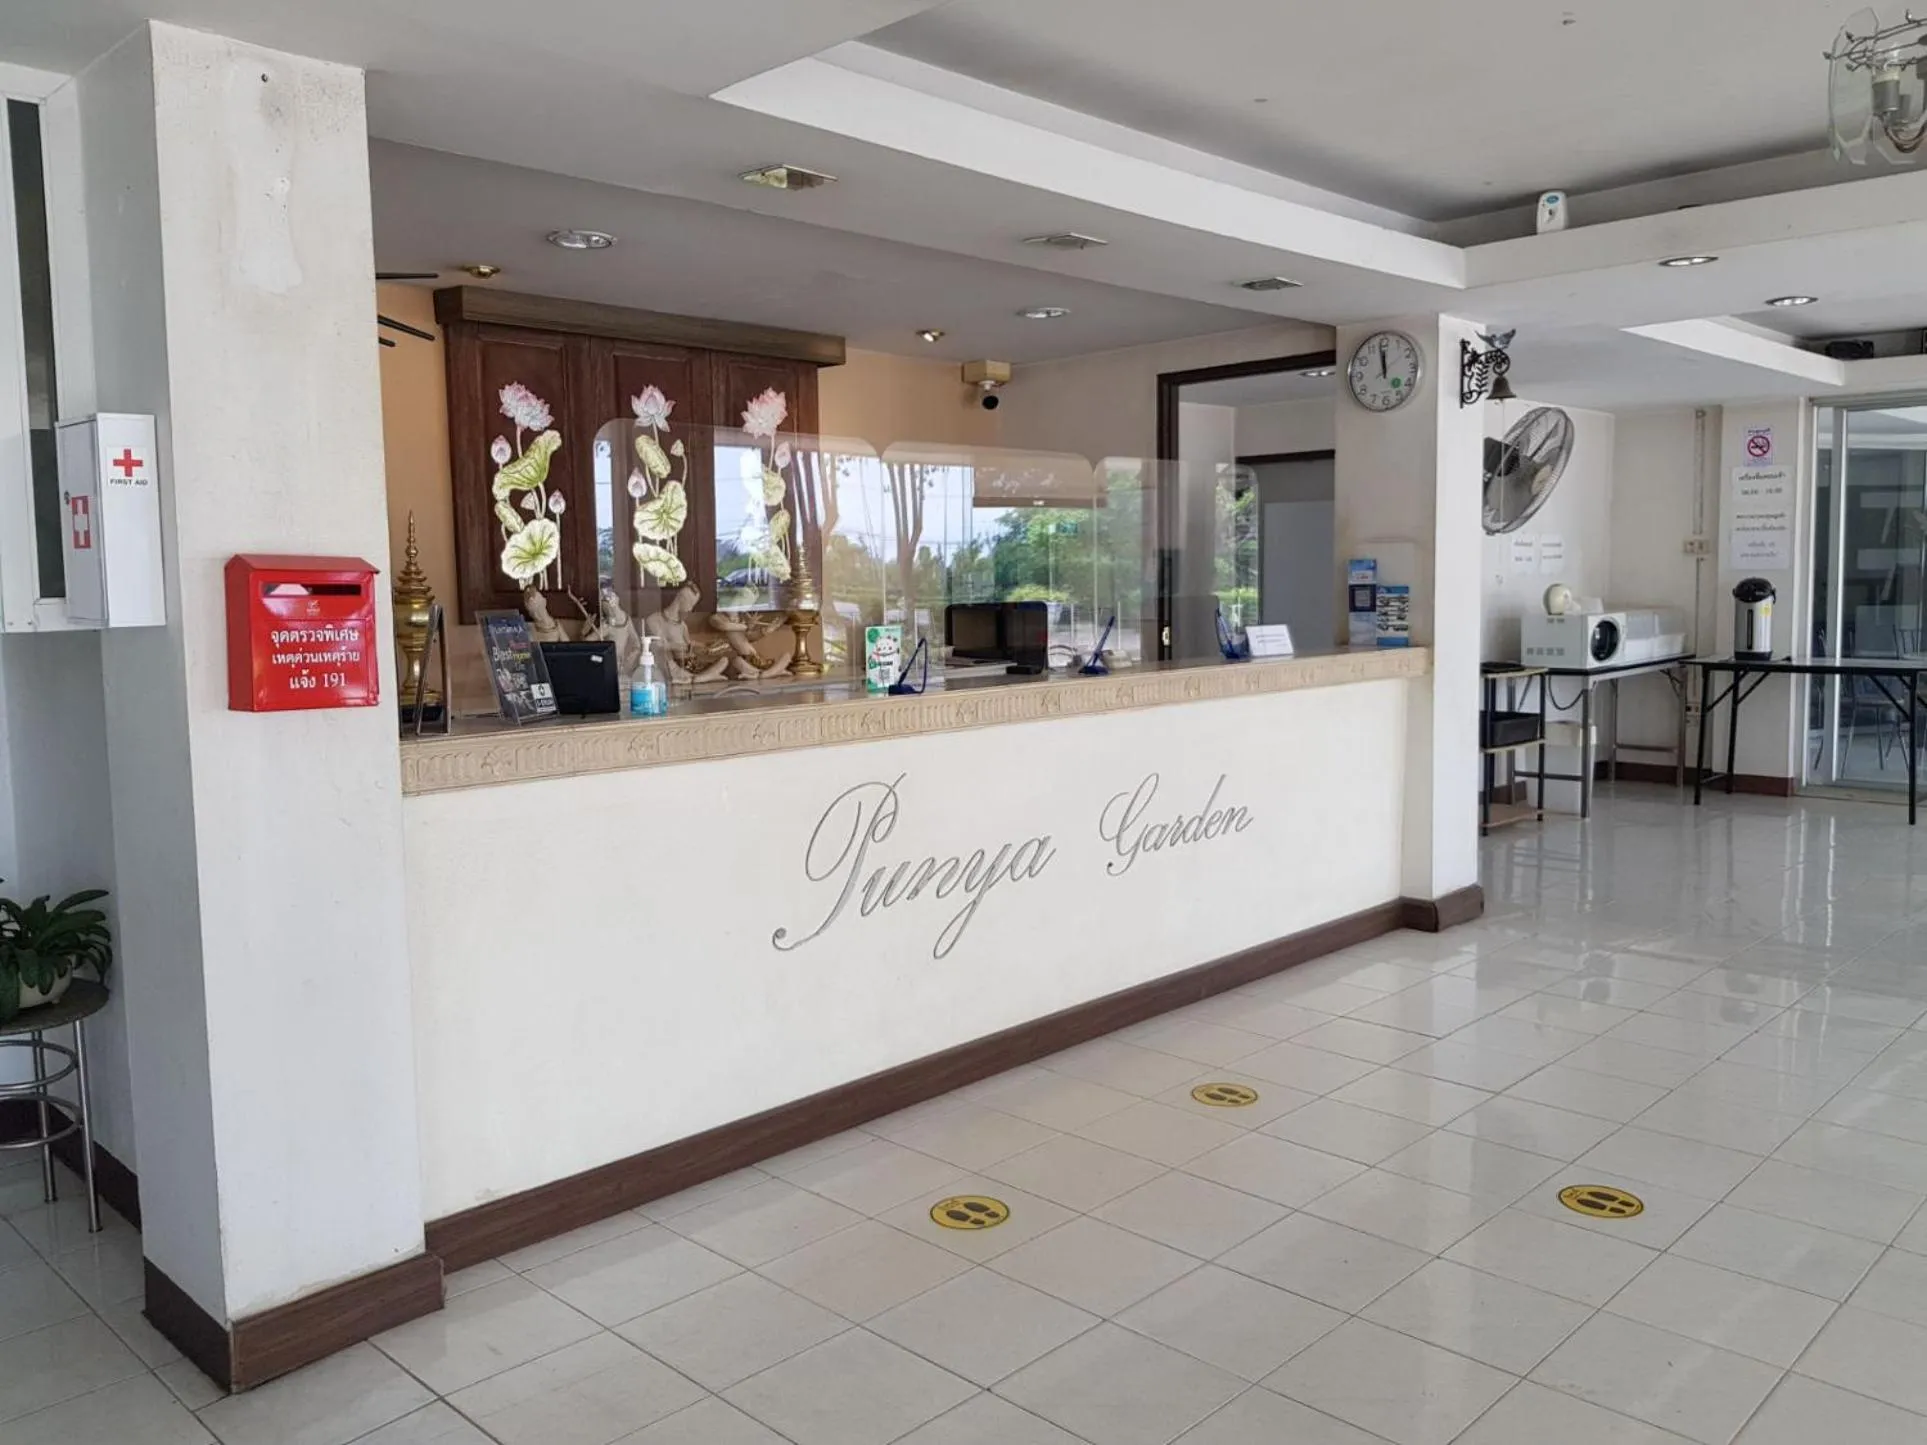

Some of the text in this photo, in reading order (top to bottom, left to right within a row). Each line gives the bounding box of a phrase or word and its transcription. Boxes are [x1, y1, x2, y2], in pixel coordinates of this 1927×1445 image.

[110, 478, 148, 486] FIRST AID
[271, 623, 359, 649] จุดตรวจพิเศษ
[272, 646, 360, 668] เหตุด่วนเหตุร้าย
[289, 668, 346, 689] แจ้ง 191
[772, 772, 1254, 960] Punya Garden
